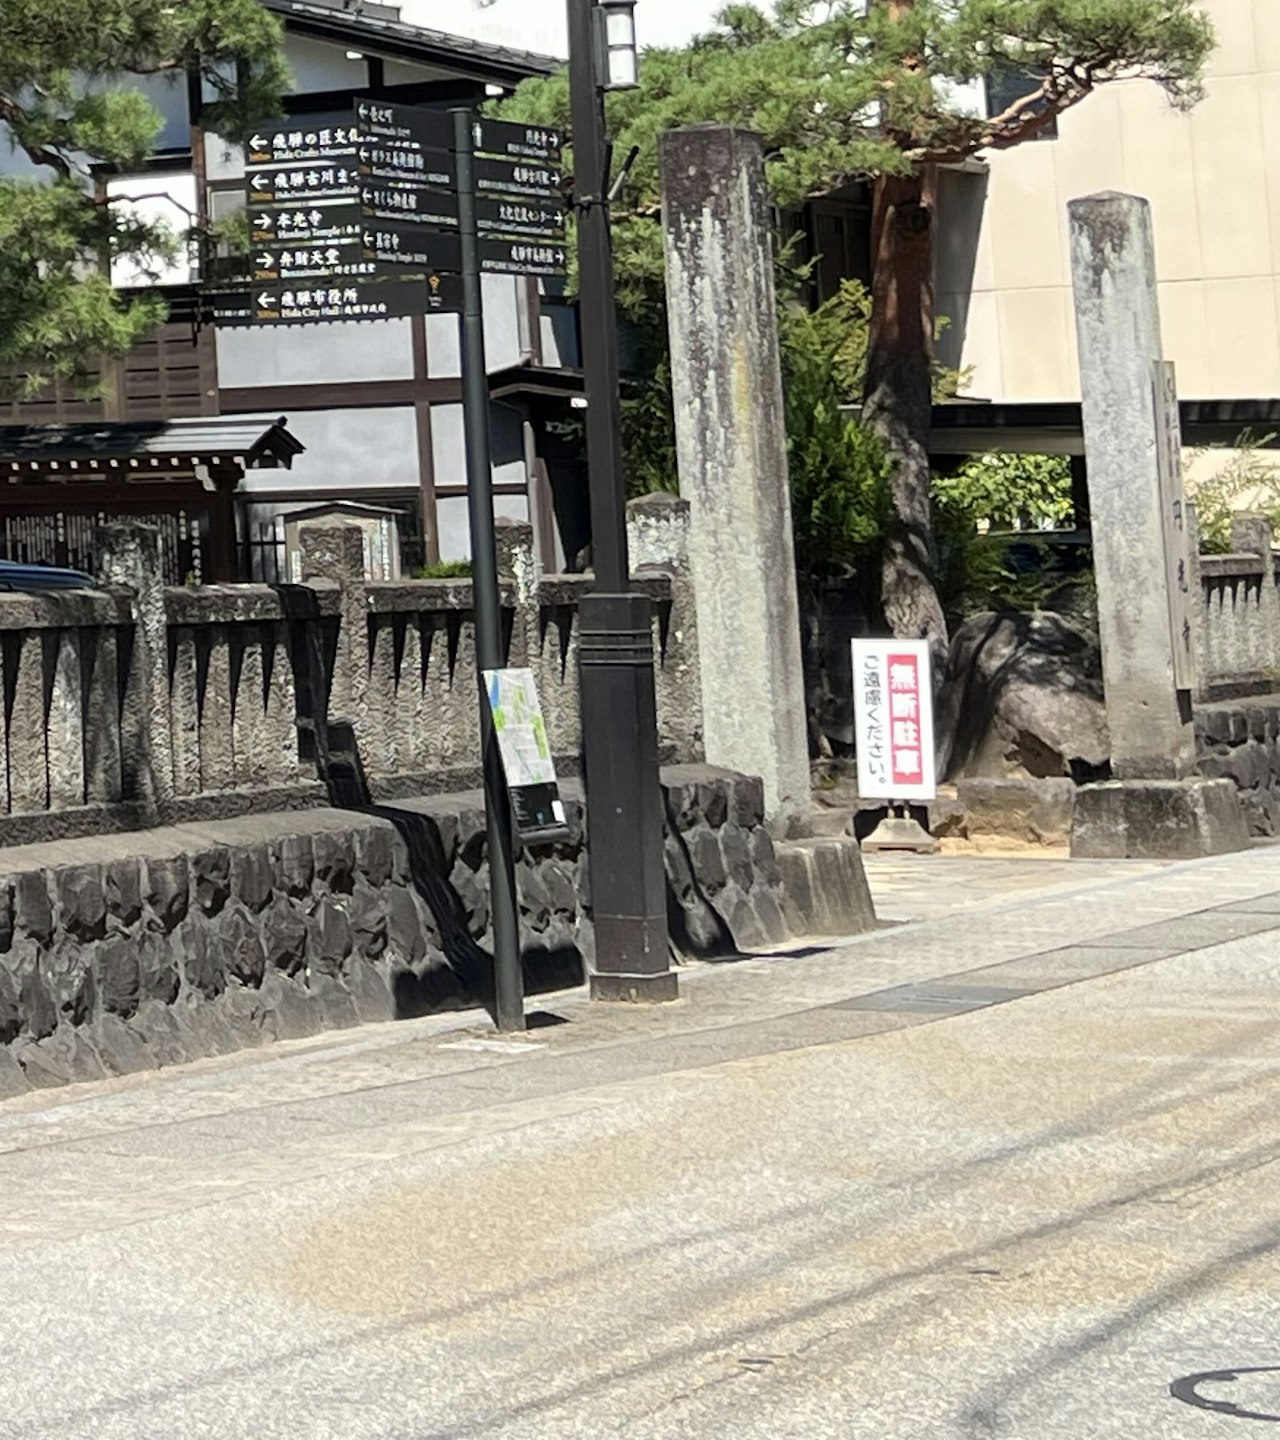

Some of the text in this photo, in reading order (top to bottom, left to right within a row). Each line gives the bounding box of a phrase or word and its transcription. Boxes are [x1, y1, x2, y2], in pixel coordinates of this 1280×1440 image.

[272, 127, 379, 148] 飛騨の匠文化
[277, 210, 323, 229] 本光寺
[279, 247, 341, 268] 弁財天堂
[281, 287, 359, 308] 飛騨市役所
[281, 307, 302, 318] Hida
[302, 306, 320, 318] City
[321, 305, 340, 316] Hall
[863, 655, 887, 785] ご遠慮ください。
[889, 662, 921, 776] 無断駐車
